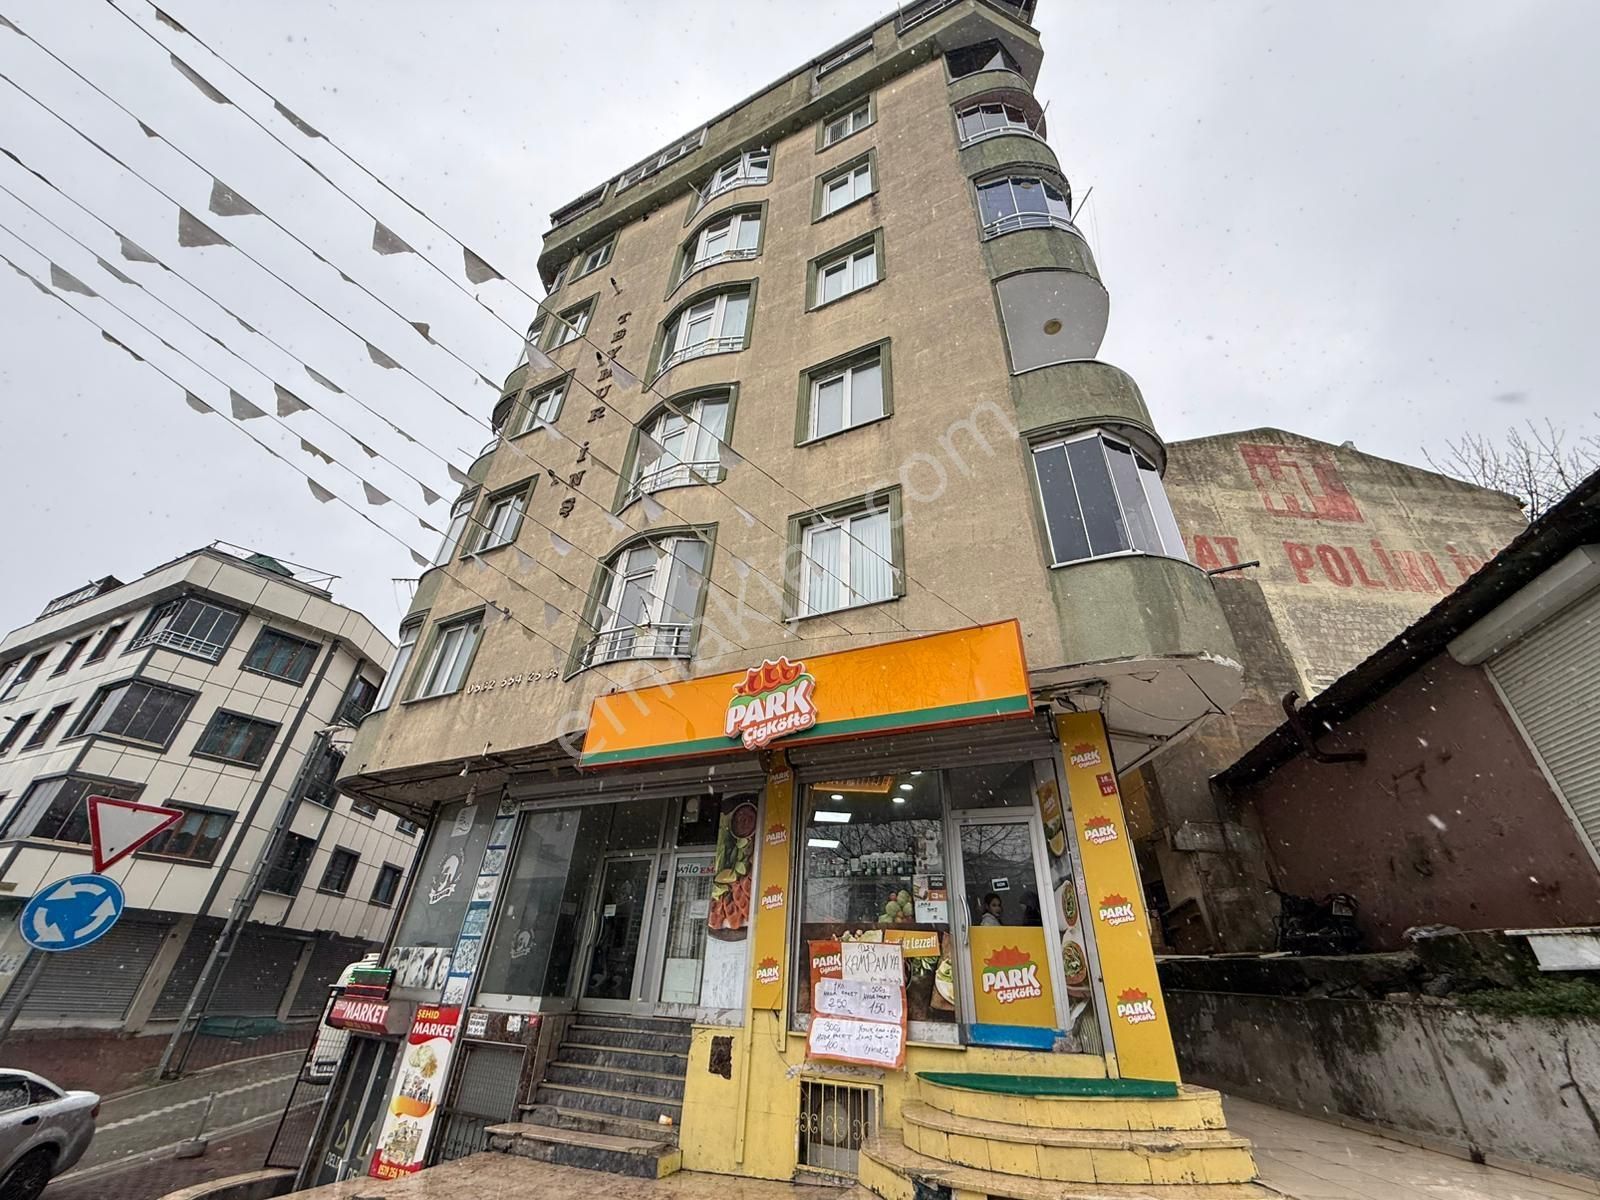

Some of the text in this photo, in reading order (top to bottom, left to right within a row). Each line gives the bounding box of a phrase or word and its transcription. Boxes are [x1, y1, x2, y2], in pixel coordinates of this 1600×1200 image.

[726, 679, 811, 735] PARK
[1070, 749, 1101, 766] PARK
[766, 829, 787, 843] PARK
[1084, 824, 1117, 841] PARK
[761, 893, 783, 906] PARK
[1099, 903, 1135, 921] PARK
[911, 935, 937, 949] Lezzet!
[812, 953, 842, 969] PARK
[844, 951, 901, 975] KAMPANYA
[756, 966, 779, 979] PARK
[982, 964, 1041, 993] PARK
[827, 998, 848, 1009] 250
[868, 1001, 886, 1015] 150
[1117, 1000, 1155, 1018] PARK
[342, 1001, 389, 1024] MARKET
[412, 1021, 457, 1037] MARKET
